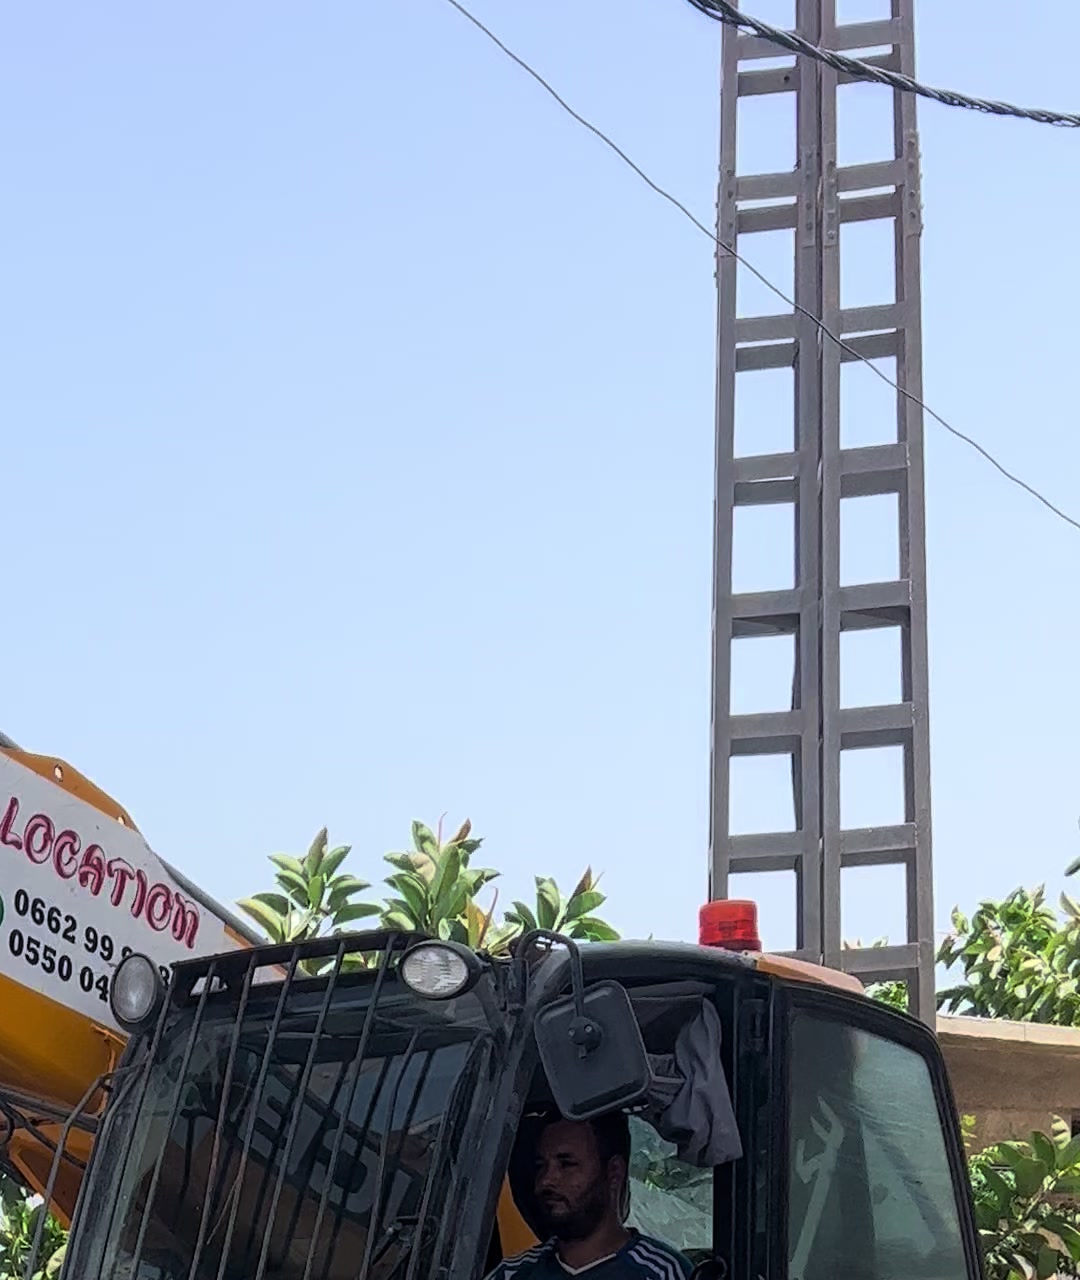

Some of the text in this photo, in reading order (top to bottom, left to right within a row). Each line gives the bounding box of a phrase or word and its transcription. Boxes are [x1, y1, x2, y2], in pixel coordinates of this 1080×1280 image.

[0, 797, 199, 949] LOCATION
[14, 889, 113, 961] 0662 99
[8, 929, 71, 982] 0550
[79, 966, 109, 1003] 04
